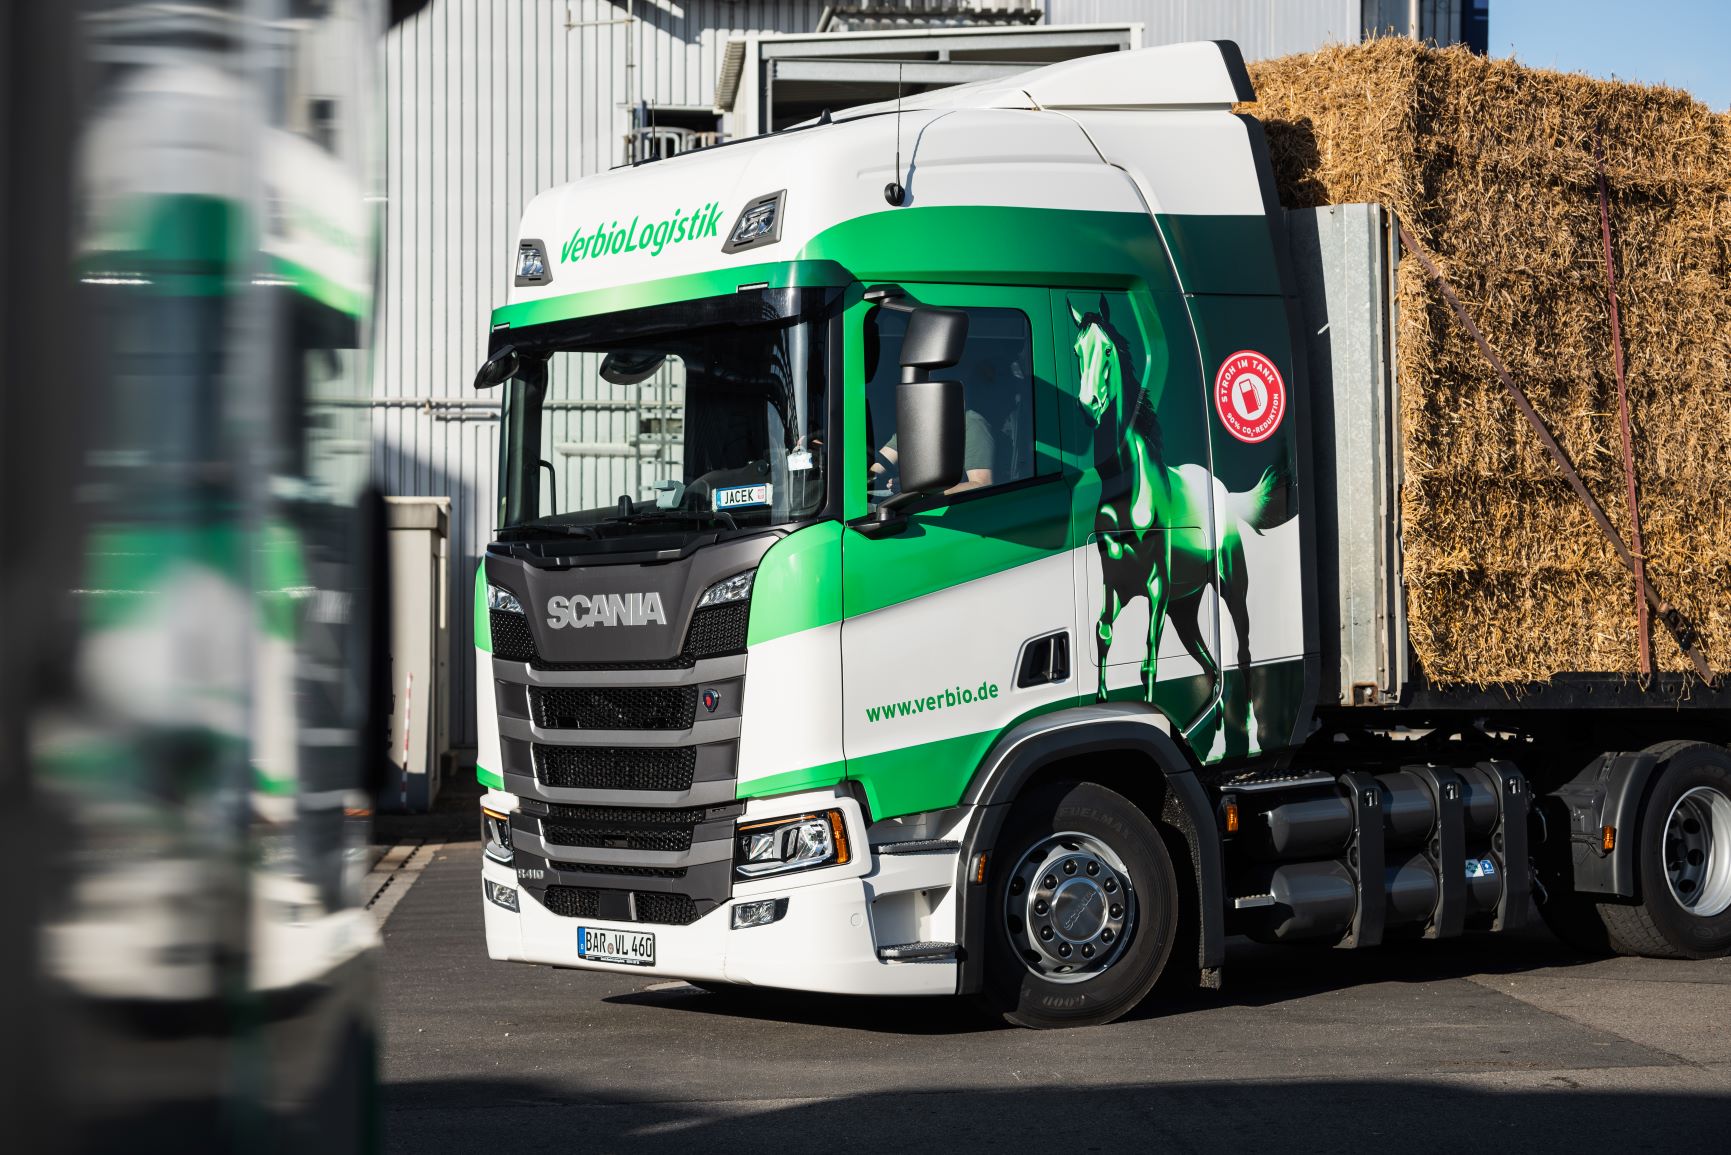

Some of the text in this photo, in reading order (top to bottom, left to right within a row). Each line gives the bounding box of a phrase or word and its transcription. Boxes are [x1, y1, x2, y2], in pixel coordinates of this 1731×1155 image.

[1221, 359, 1275, 403] STROH IM TANK
[725, 488, 754, 504] JACEK
[546, 591, 668, 630] SCANIA
[866, 681, 999, 723] www.verbio.de
[585, 931, 606, 954] BAR
[615, 934, 629, 955] VL
[631, 936, 653, 958] 460
